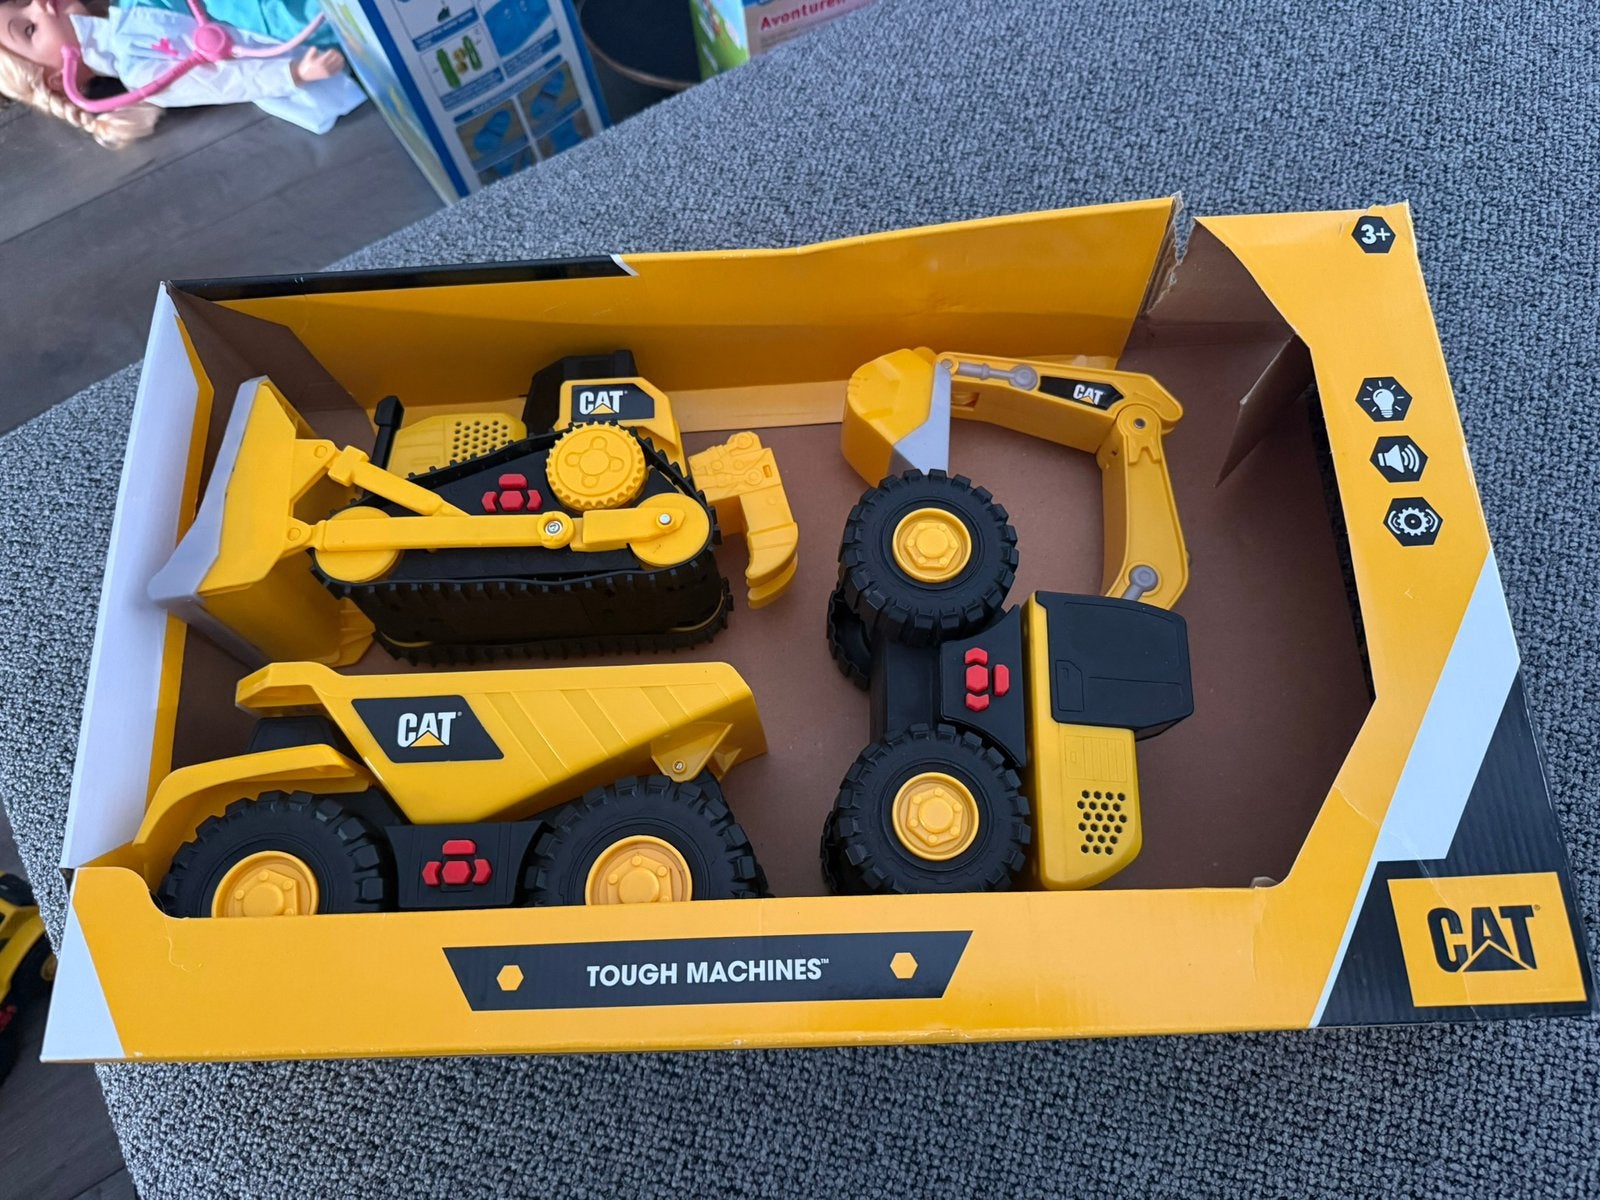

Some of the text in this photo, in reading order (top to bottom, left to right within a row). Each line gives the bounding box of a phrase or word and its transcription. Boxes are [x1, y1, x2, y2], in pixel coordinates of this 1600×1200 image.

[1361, 224, 1391, 245] 3+
[1073, 384, 1104, 405] CAT
[586, 963, 678, 987] TOUGH
